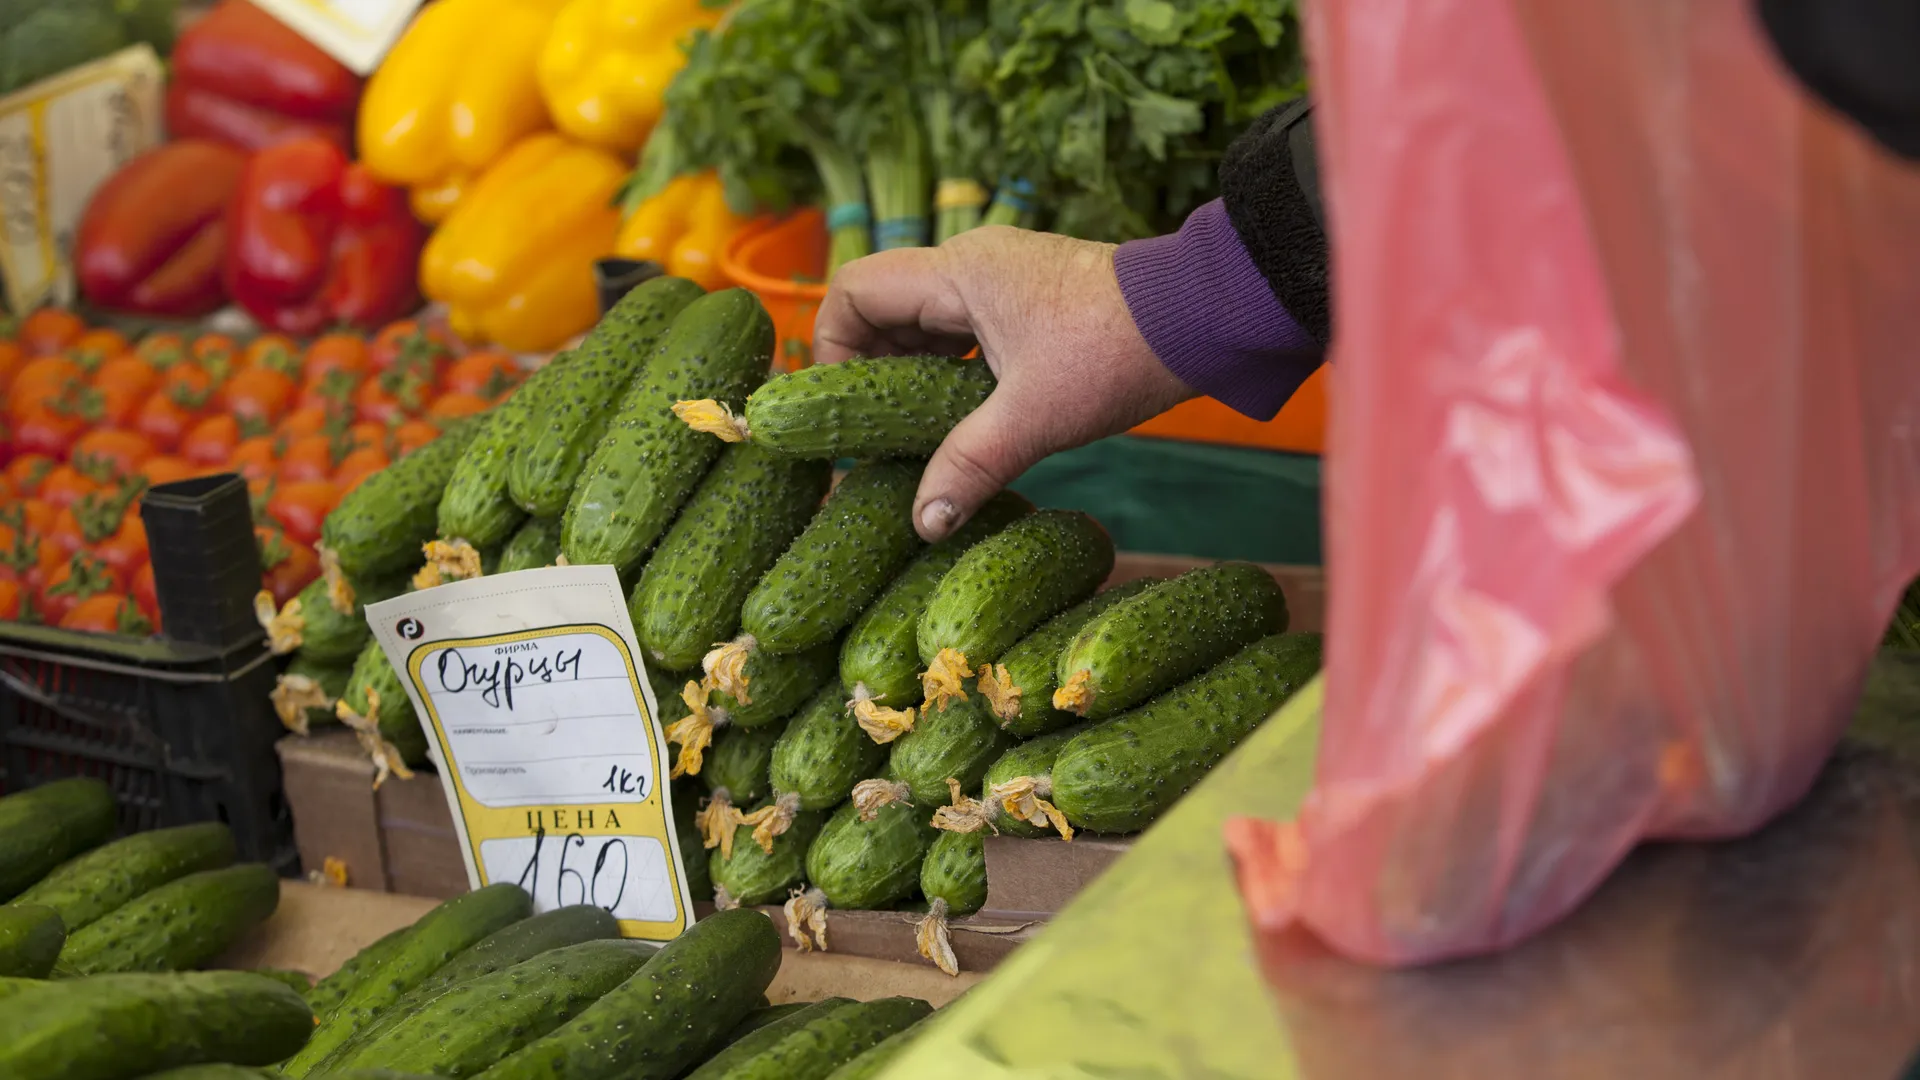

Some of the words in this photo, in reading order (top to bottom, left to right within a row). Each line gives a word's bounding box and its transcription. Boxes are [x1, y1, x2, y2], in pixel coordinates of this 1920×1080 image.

[494, 641, 539, 655] ФИРМА
[438, 648, 582, 711] Огурцы
[526, 809, 622, 833] ЦЕНА
[518, 827, 629, 914] 160
